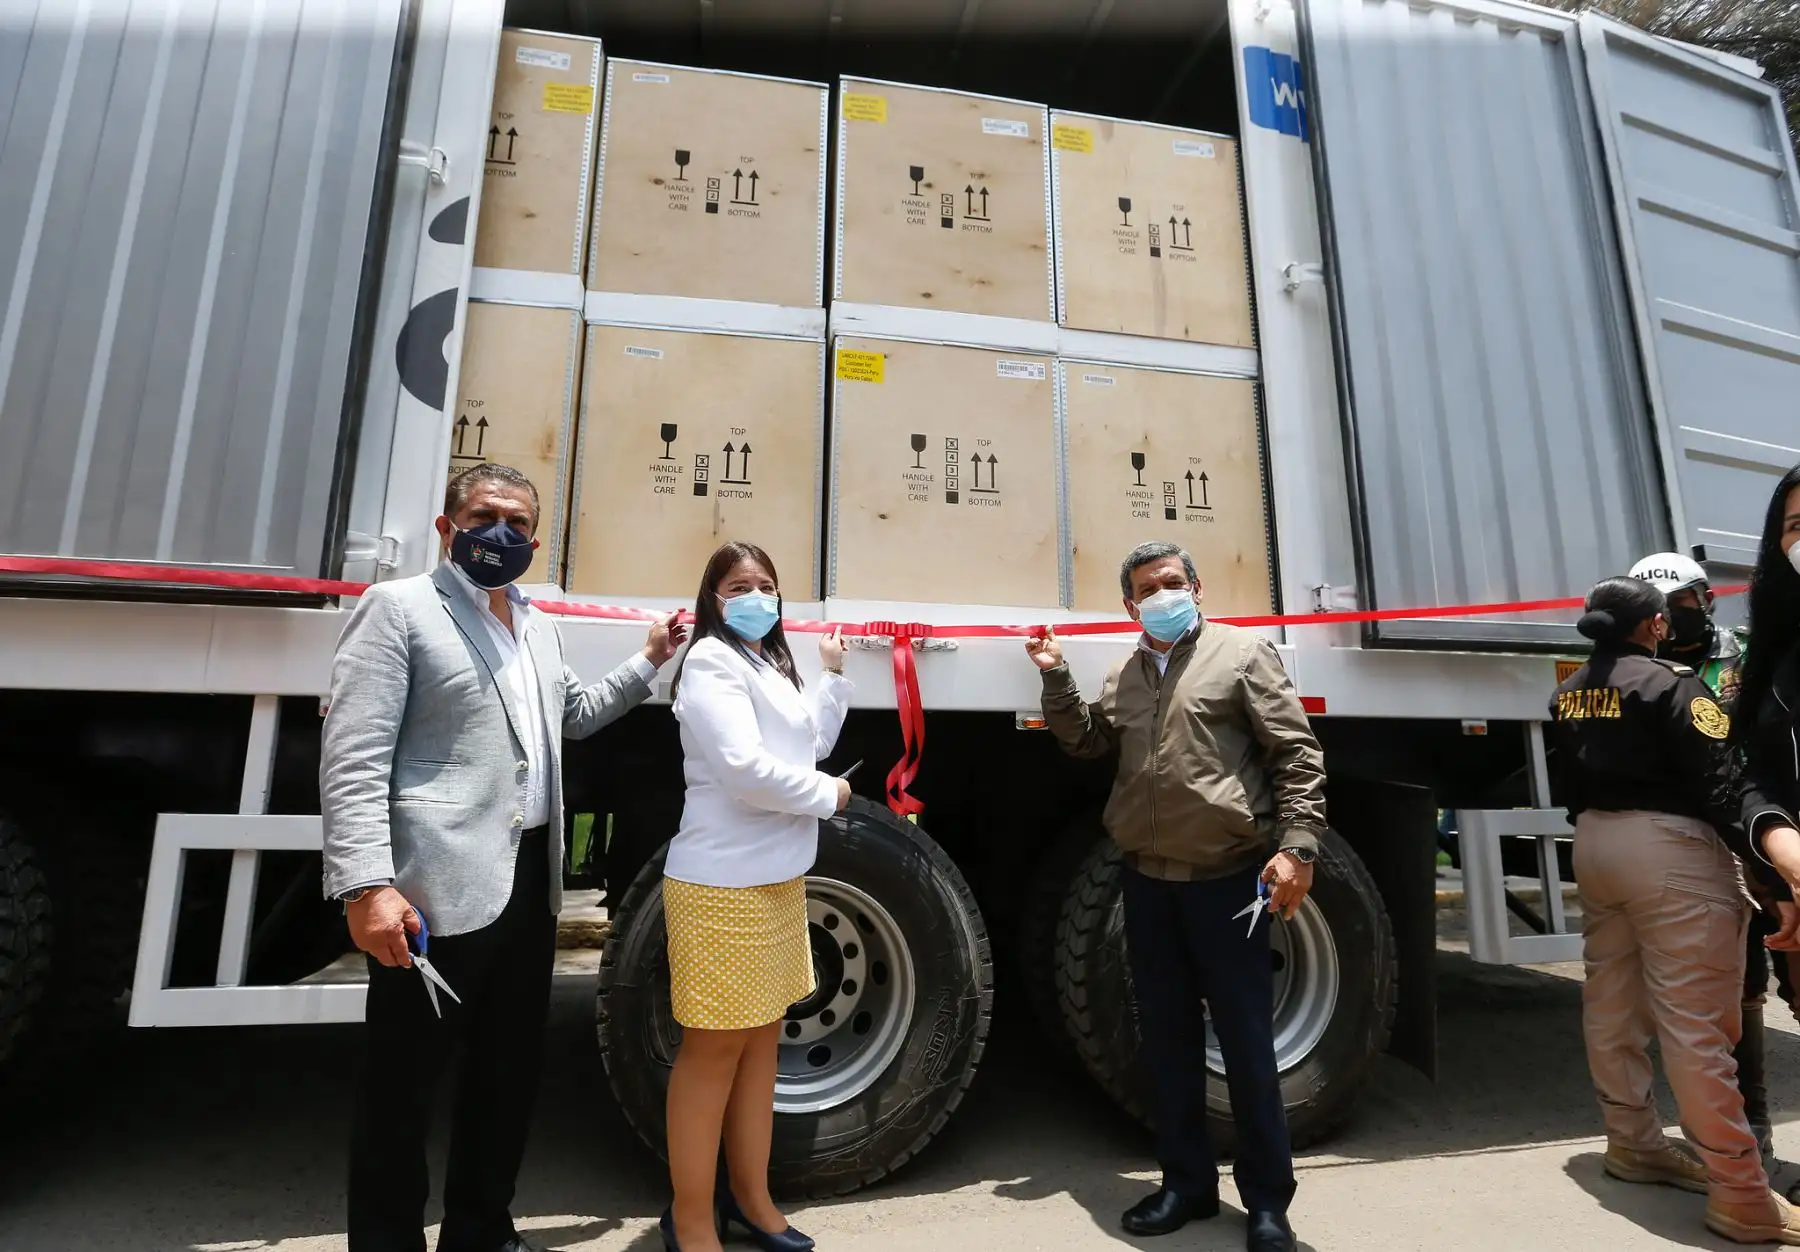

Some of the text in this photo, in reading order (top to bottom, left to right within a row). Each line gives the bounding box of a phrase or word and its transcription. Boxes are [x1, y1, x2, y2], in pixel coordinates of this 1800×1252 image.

[498, 112, 515, 120] TOP
[740, 156, 755, 164] TOP
[664, 184, 695, 193] HANDLE
[668, 202, 688, 211] CARE
[901, 199, 931, 208] HANDLE
[1172, 204, 1185, 212] TOP
[727, 208, 761, 218] BOTTOM
[906, 208, 926, 216] WITH
[906, 217, 925, 225] CARE
[962, 223, 993, 233] BOTTOM
[1112, 229, 1139, 238] HANDLE
[1118, 238, 1136, 246] WITH
[1119, 247, 1135, 255] CARE
[1169, 253, 1197, 262] BOTTOM
[466, 399, 484, 408] TOP
[730, 427, 746, 436] TOP
[976, 439, 992, 447] TOP
[1188, 456, 1202, 465] TOP
[649, 464, 684, 473] HANDLE
[654, 475, 676, 483] WITH
[902, 473, 934, 482] HANDLE
[653, 485, 676, 494] CARE
[908, 483, 929, 491] WITH
[717, 489, 753, 499] BOTTOM
[908, 493, 929, 502] CARE
[1125, 490, 1154, 499] HANDLE
[968, 498, 1002, 507] BOTTOM
[1131, 500, 1150, 509] WITH
[1131, 510, 1151, 519] CARE
[1185, 514, 1215, 523] BOTTOM
[1634, 569, 1680, 582] OLICIA
[1558, 687, 1621, 720] POLICIA
